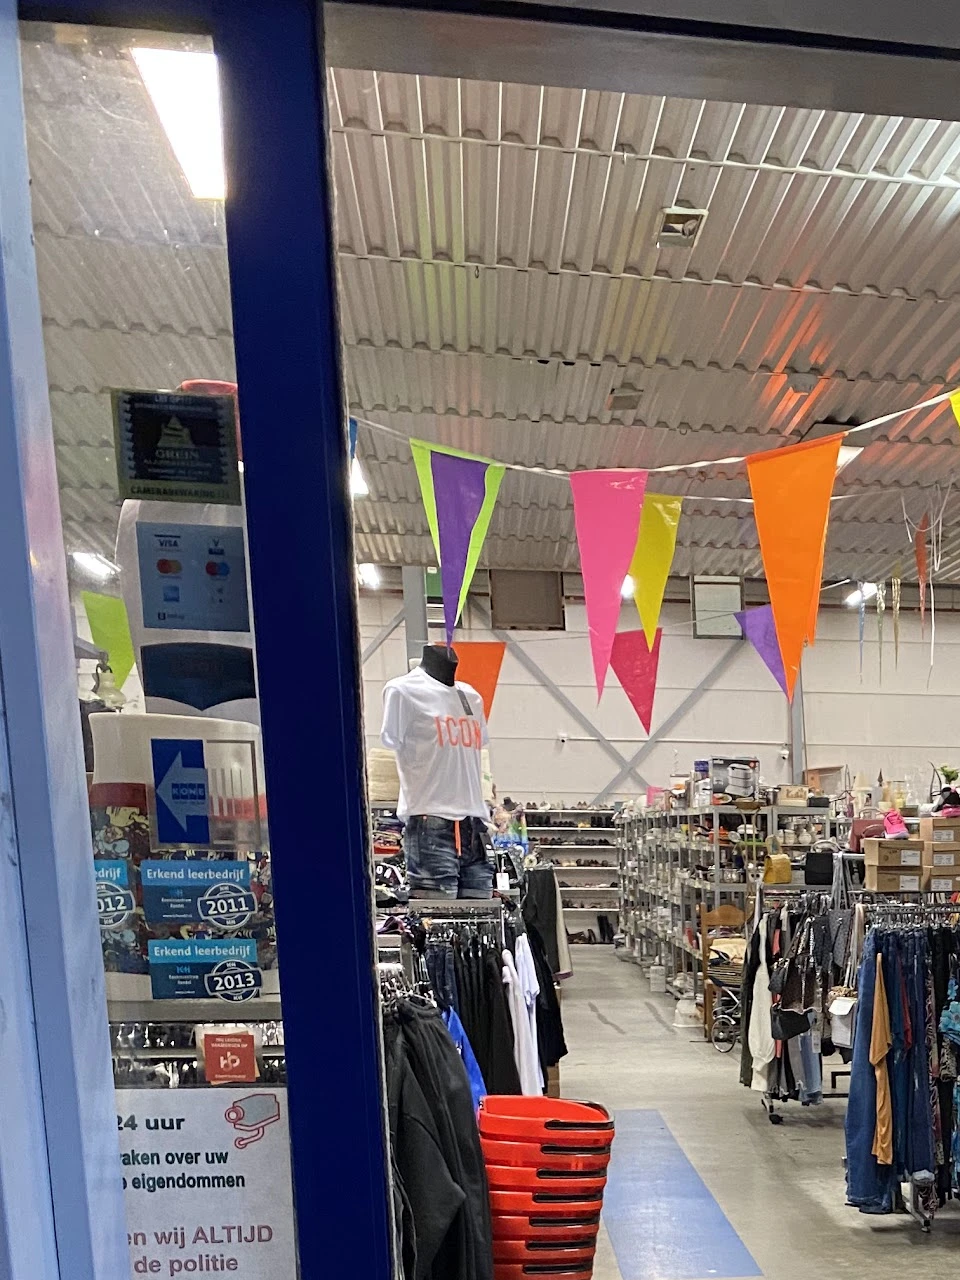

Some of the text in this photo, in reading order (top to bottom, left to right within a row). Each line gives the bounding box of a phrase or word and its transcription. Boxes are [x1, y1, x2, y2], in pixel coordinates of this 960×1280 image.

[158, 539, 178, 548] VISA
[434, 716, 481, 750] ICON
[172, 785, 205, 798] KONE
[147, 869, 184, 879] Erkend
[187, 869, 244, 882] leerbedrijf
[205, 896, 249, 915] 2011
[154, 946, 251, 959] Erkend leerbedrijf
[213, 972, 255, 991] 2013
[145, 1117, 185, 1130] uur
[121, 1149, 229, 1166] aken over uw
[132, 1172, 246, 1192] eigendommen
[154, 1227, 185, 1248] wij
[192, 1225, 273, 1244] ALTIJD
[134, 1253, 238, 1277] de politie
